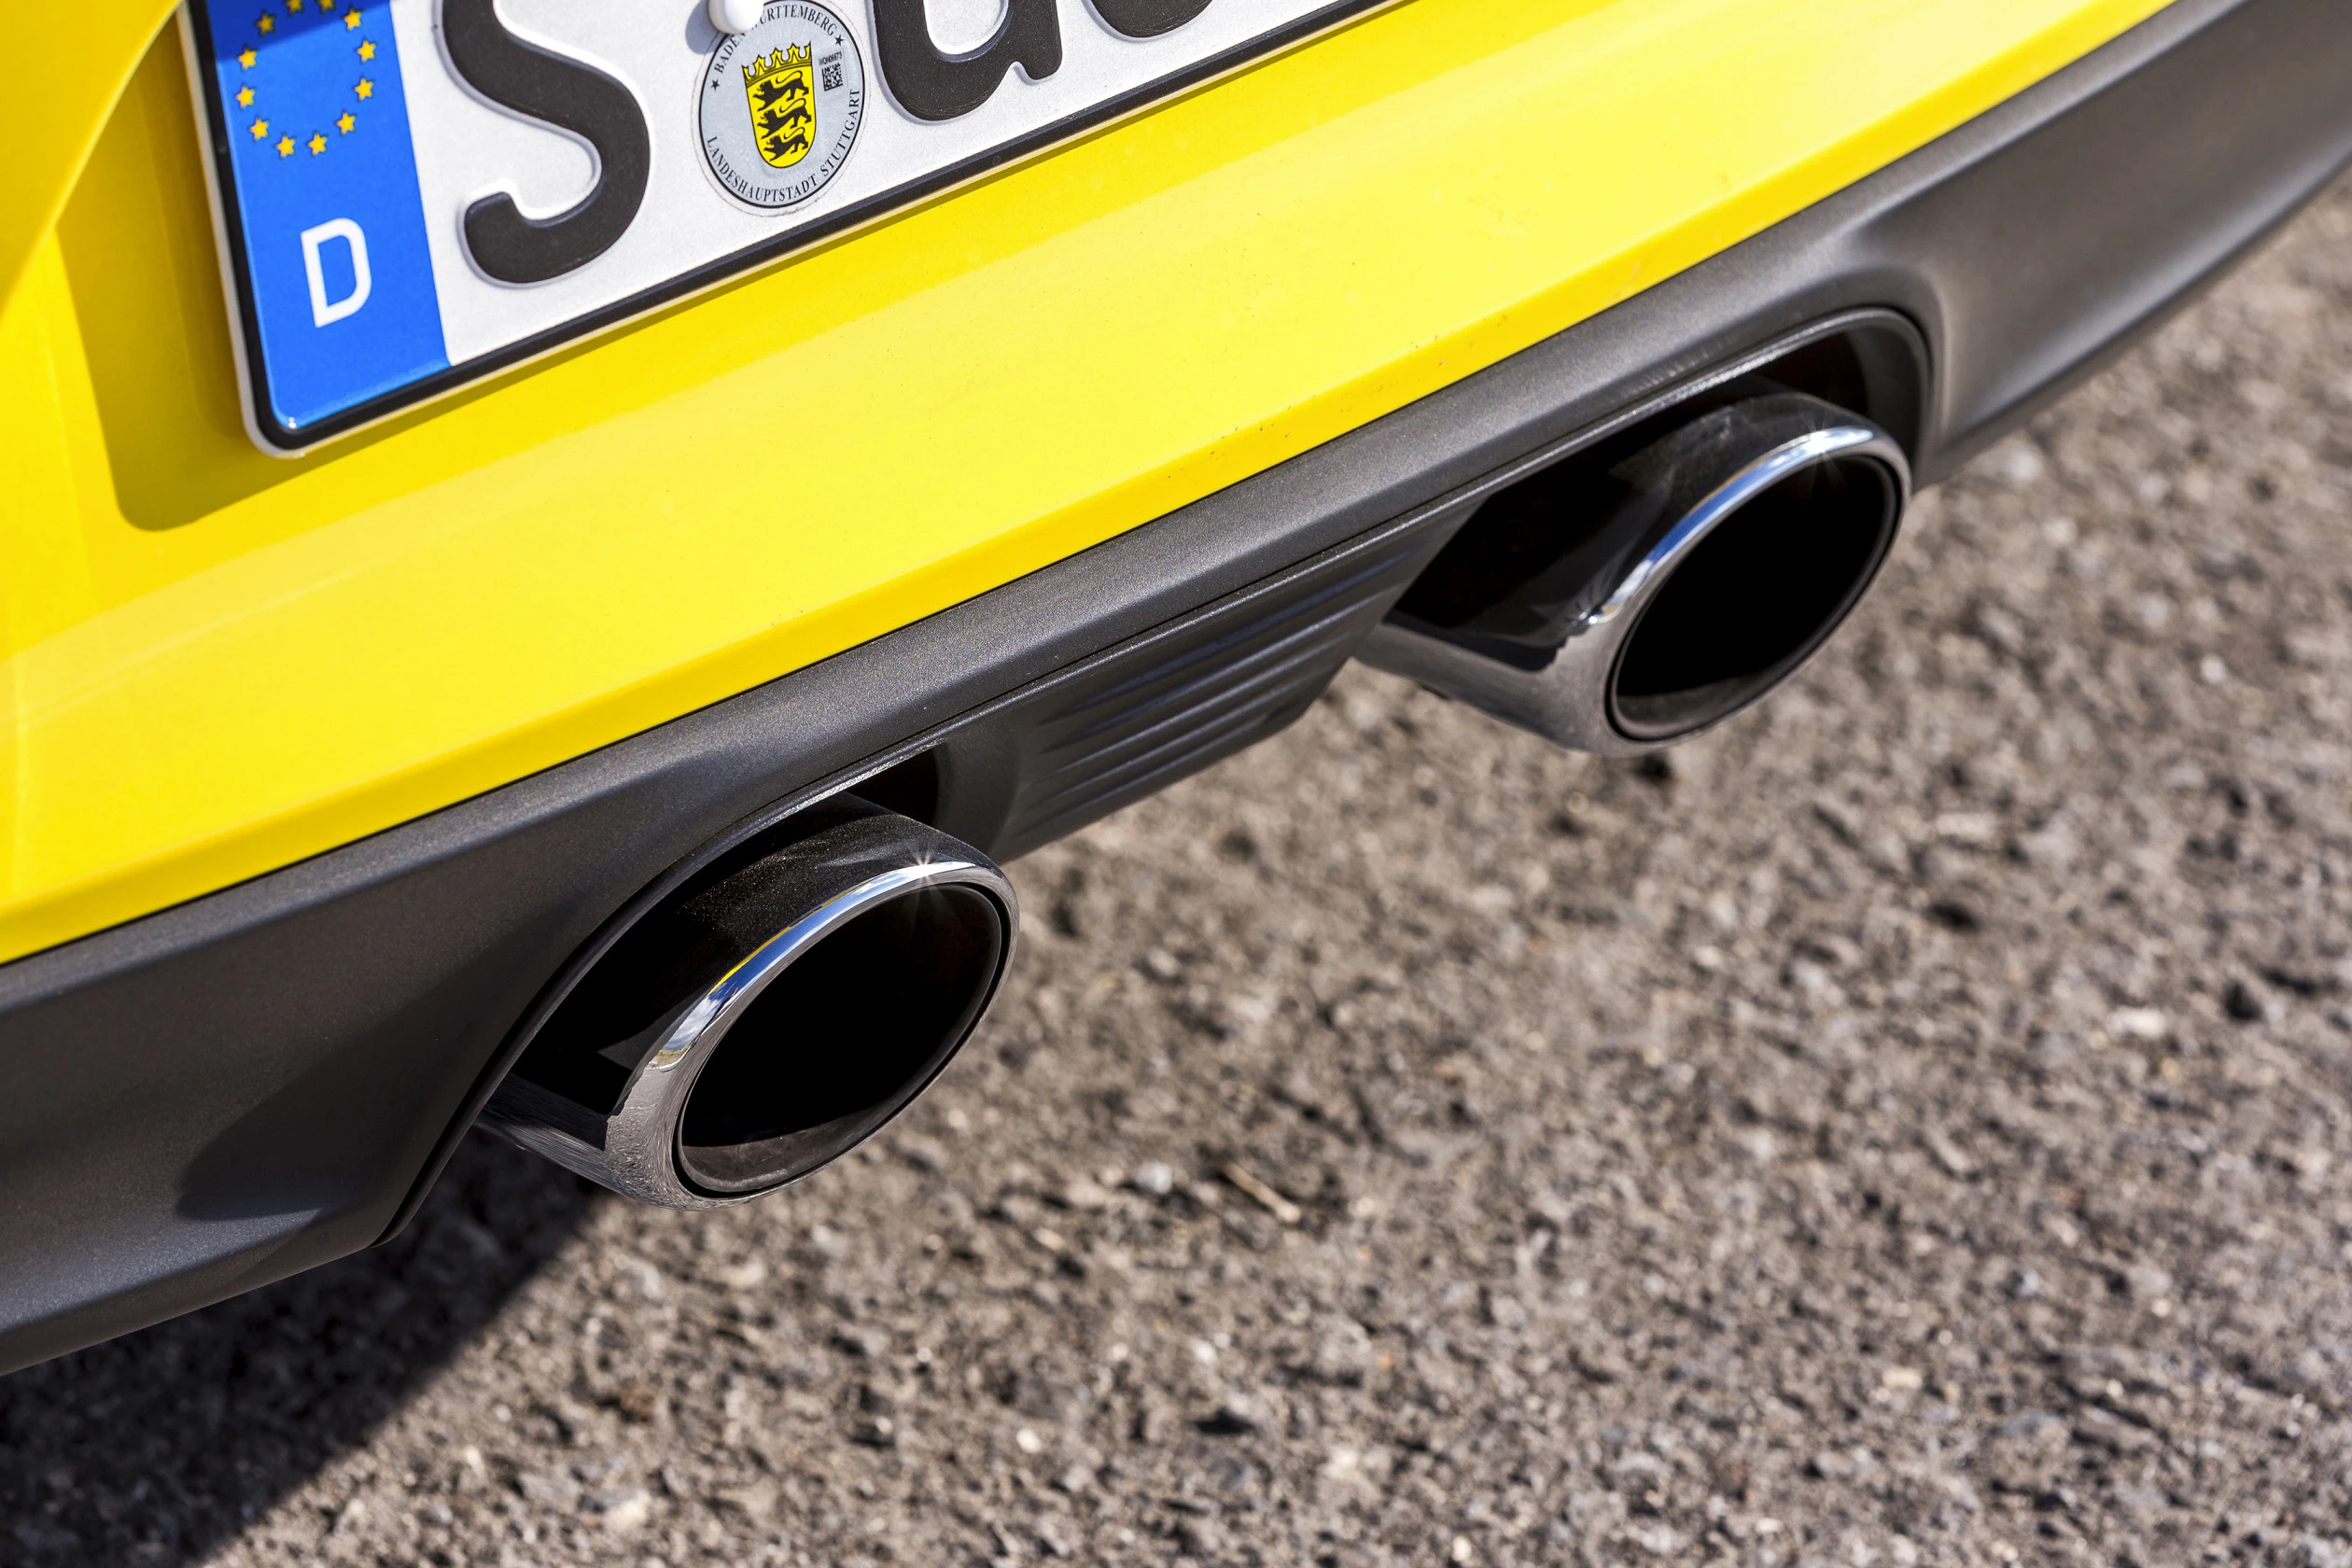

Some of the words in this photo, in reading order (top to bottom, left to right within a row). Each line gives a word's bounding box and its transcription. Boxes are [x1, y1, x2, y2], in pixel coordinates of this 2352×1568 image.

[441, 0, 651, 284] S
[707, 136, 818, 202] LANDESHAUPTSTADT
[819, 89, 861, 177] STUTTGART
[300, 217, 372, 328] D
